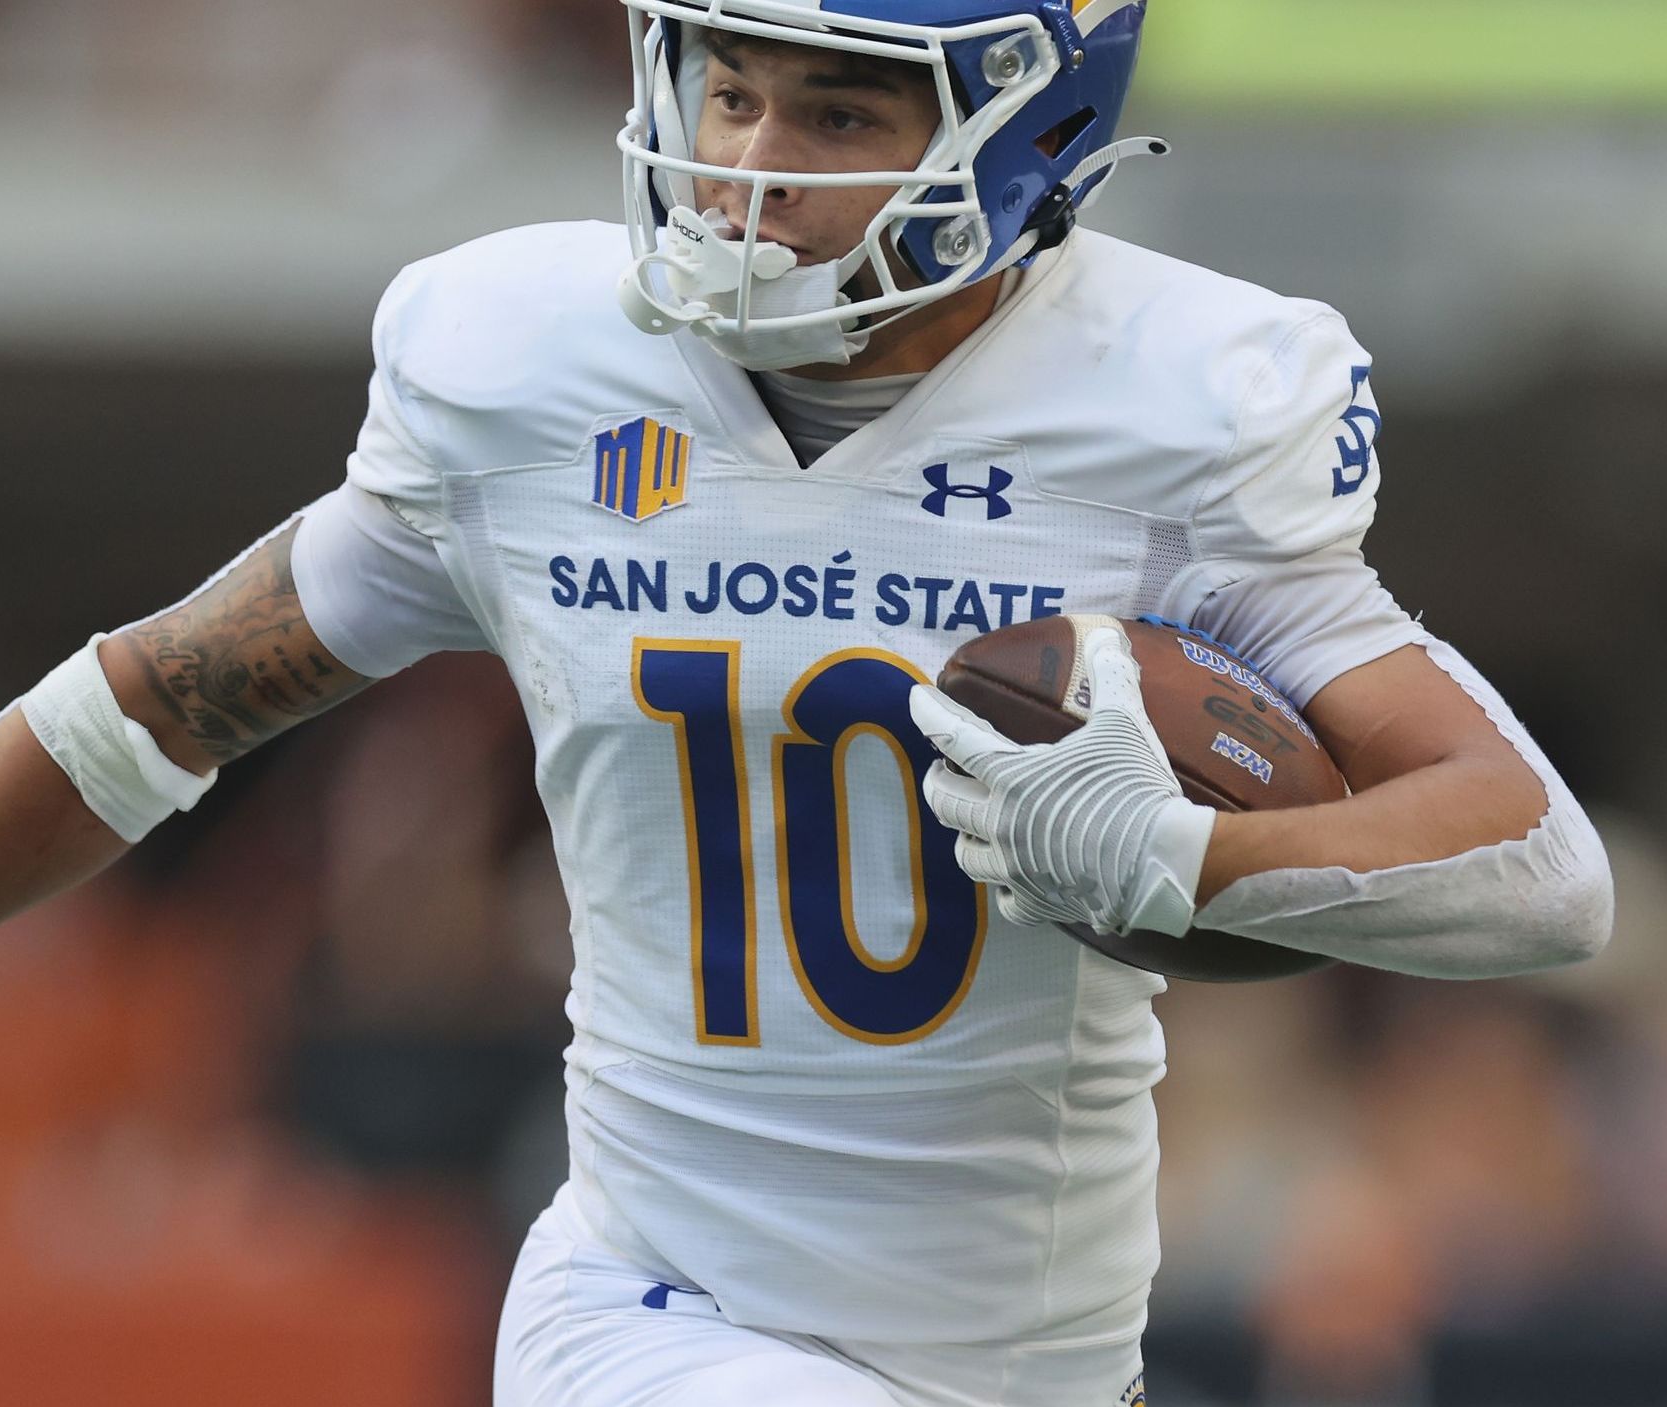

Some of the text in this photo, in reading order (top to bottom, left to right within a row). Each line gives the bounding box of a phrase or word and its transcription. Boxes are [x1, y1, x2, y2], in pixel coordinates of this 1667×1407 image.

[671, 215, 705, 246] SHOCK
[549, 550, 1065, 634] SAN JOSÉ STATE
[1202, 694, 1300, 755] GST
[1210, 731, 1274, 785] NCAA
[631, 636, 988, 1047] 10
